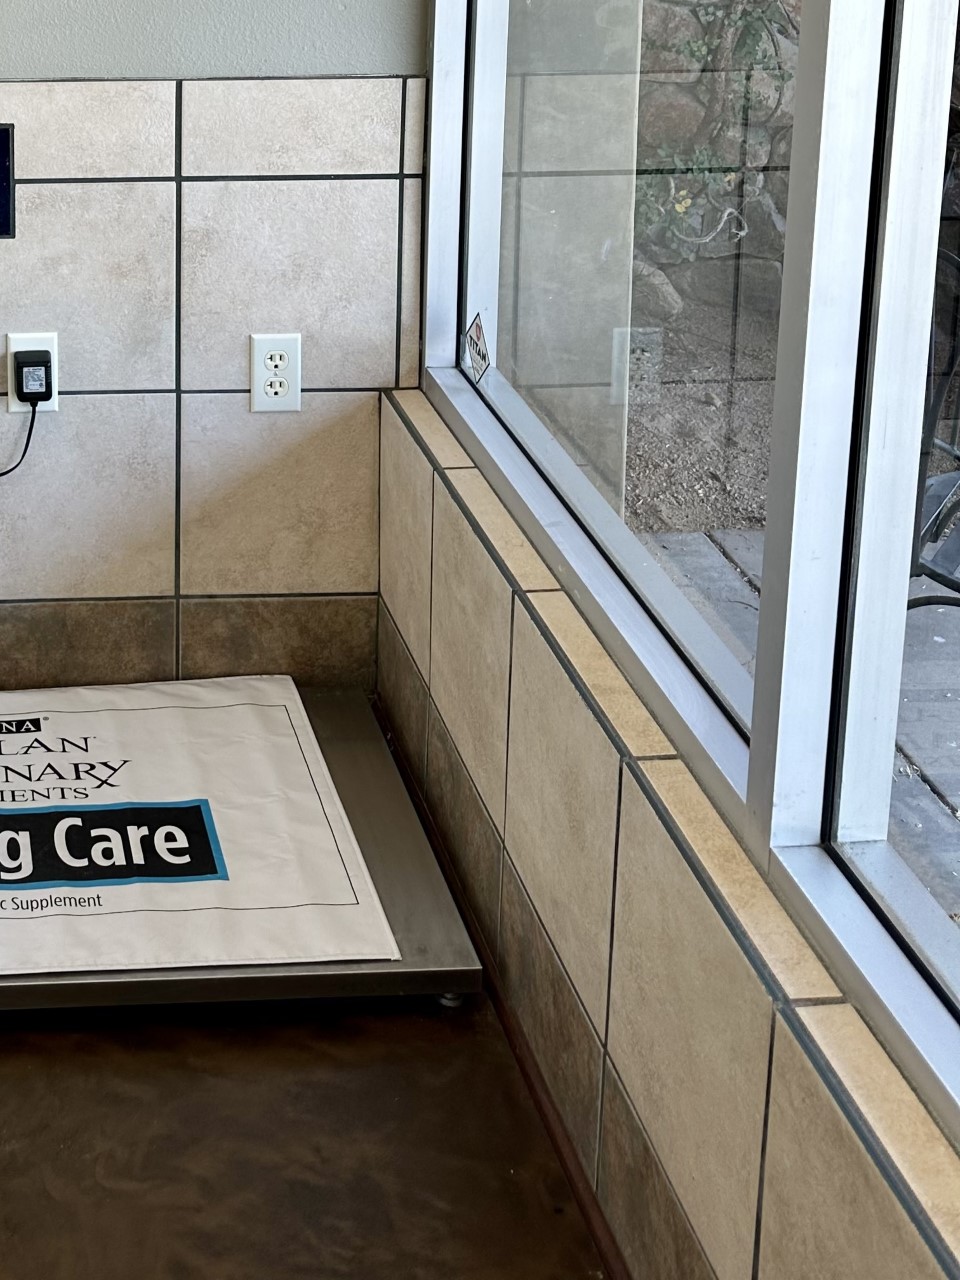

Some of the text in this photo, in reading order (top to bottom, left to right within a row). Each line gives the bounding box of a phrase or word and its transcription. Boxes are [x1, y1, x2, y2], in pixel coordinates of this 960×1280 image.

[470, 335, 486, 363] TITAN
[54, 817, 191, 868] Care
[12, 893, 102, 912] Supplement
